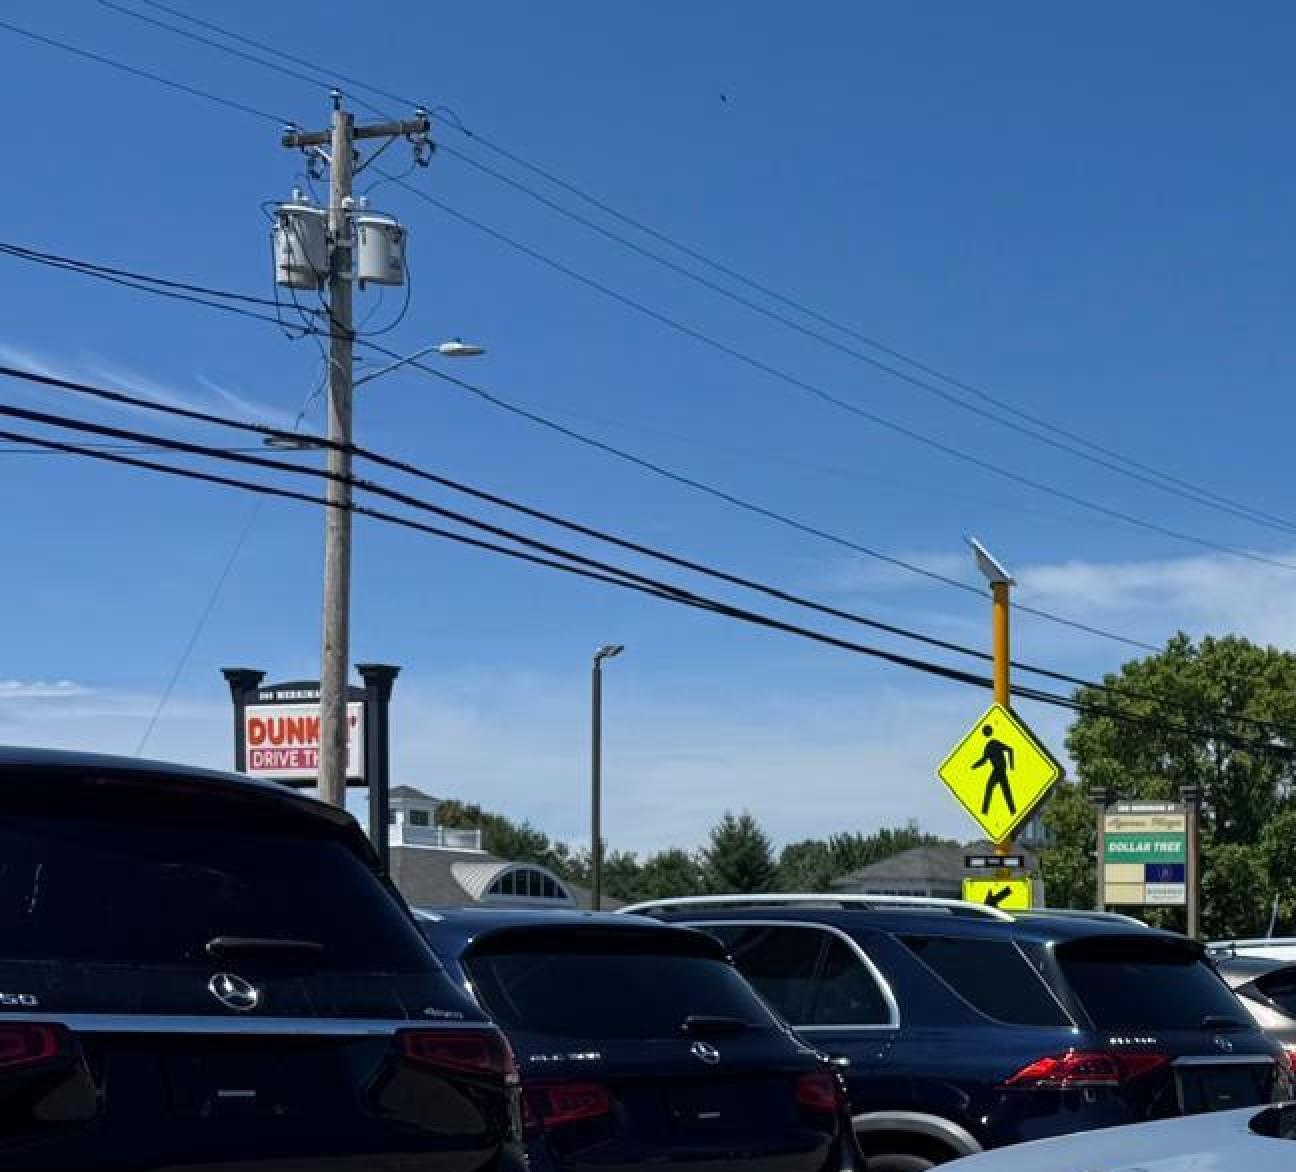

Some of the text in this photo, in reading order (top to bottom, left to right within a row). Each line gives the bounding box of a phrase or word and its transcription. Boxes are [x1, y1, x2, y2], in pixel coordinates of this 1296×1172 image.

[253, 751, 299, 767] DRIVE
[1108, 841, 1183, 853] DOLLAR TREE
